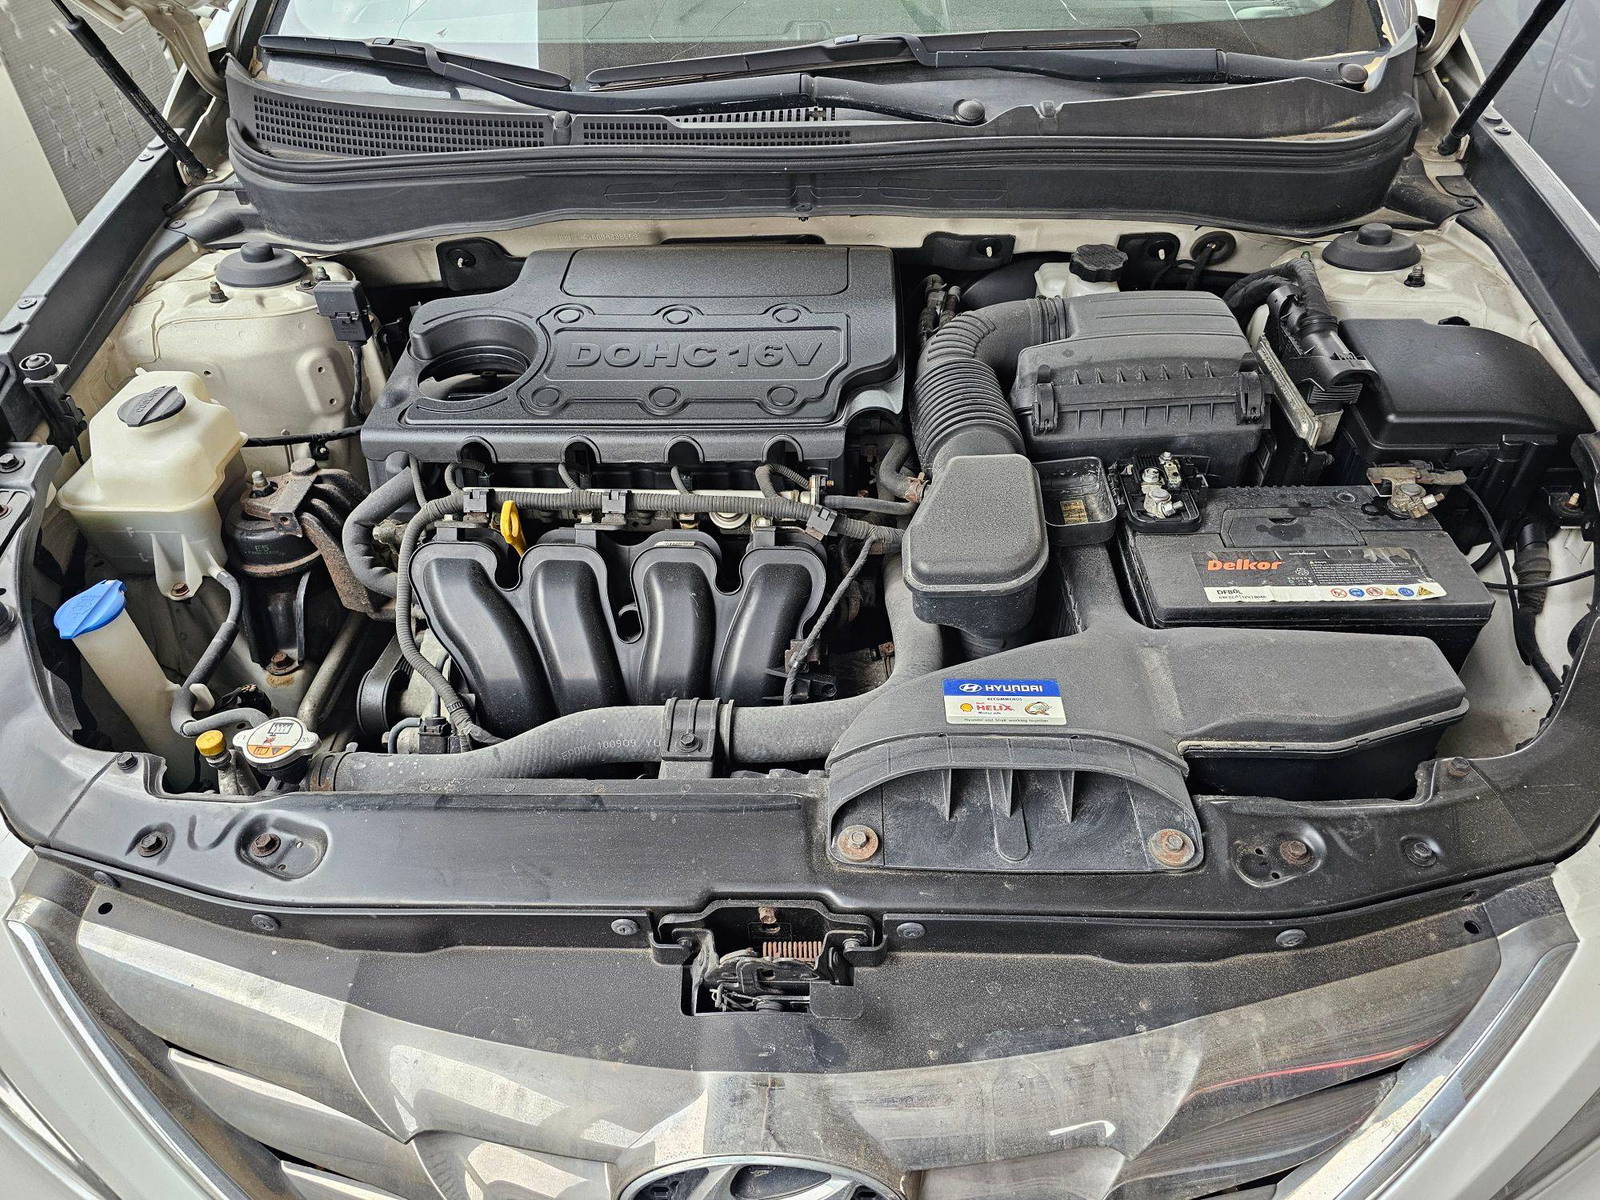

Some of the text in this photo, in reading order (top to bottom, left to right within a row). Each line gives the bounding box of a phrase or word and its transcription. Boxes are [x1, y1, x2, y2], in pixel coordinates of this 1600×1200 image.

[566, 342, 823, 368] DOHC 16V
[1207, 558, 1285, 571] Delkor
[985, 684, 1043, 692] HYUNDAI
[976, 704, 1015, 712] HELIX
